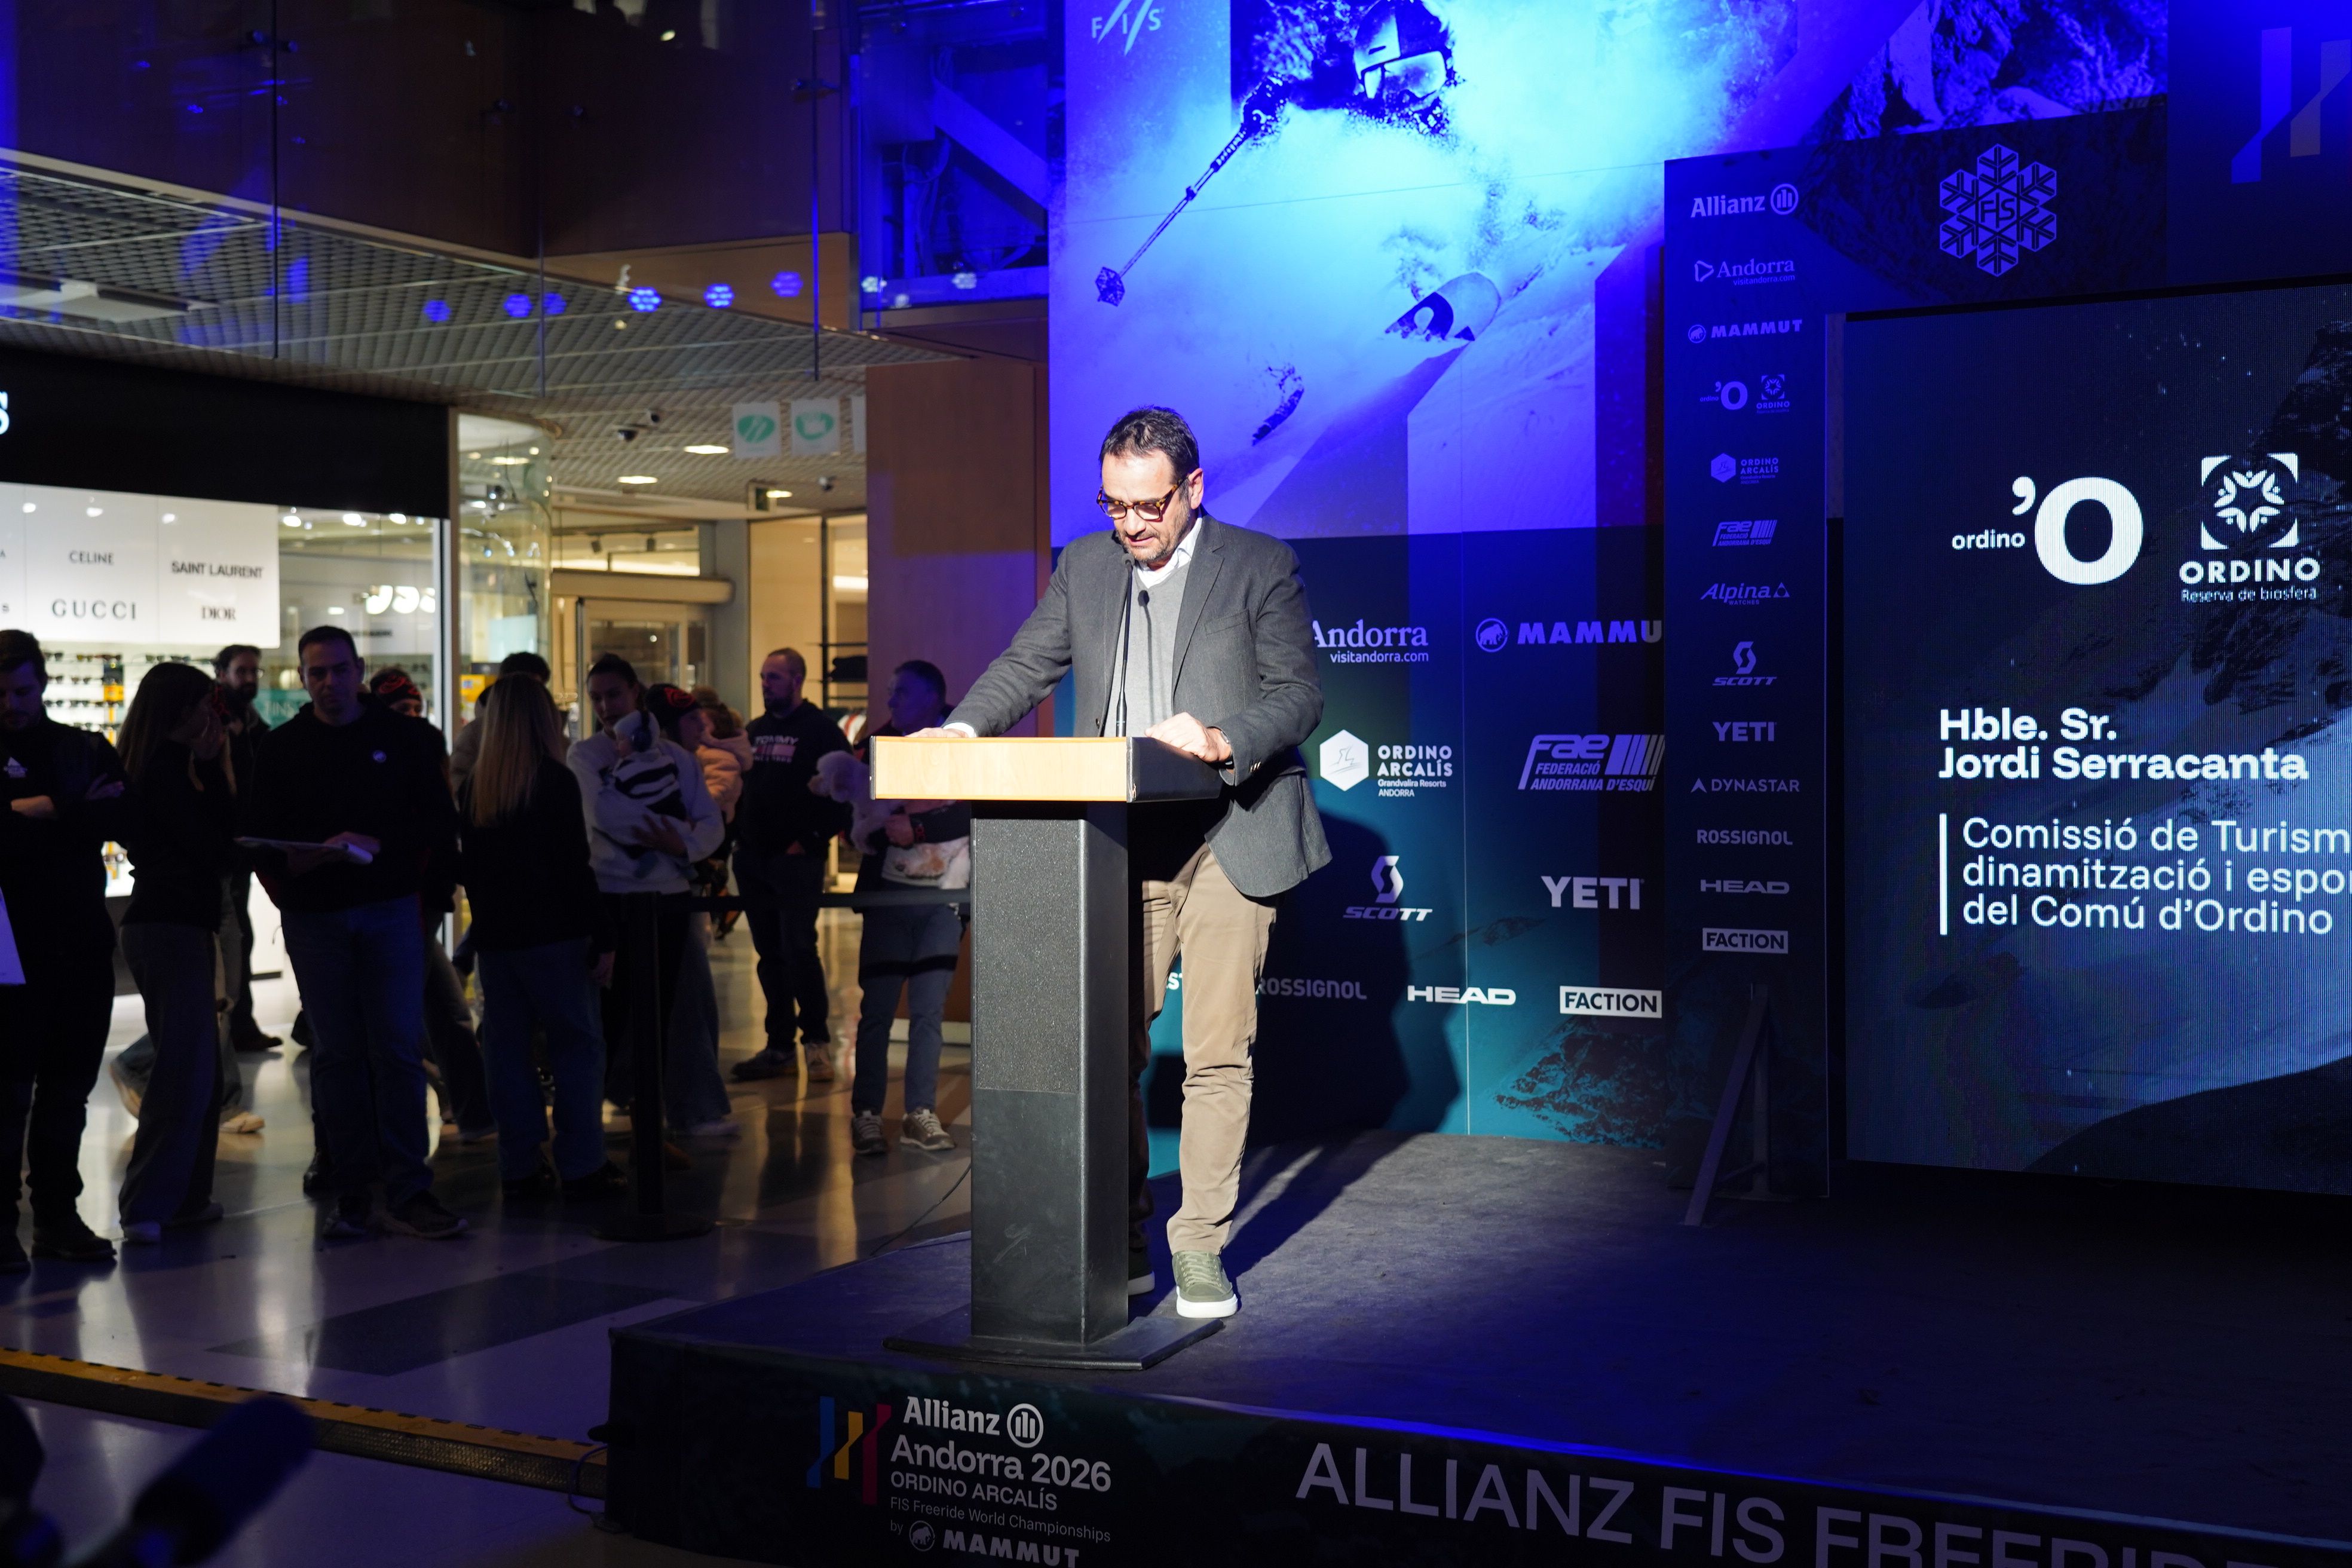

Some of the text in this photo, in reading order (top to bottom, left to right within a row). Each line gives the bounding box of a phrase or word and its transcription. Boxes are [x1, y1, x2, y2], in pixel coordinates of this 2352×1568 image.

[1690, 194, 1766, 218] Allianz
[1717, 258, 1795, 278] Andorra
[1733, 274, 1796, 286] visitandorra.com
[1711, 320, 1803, 338] MAMMUT
[1699, 395, 1719, 405] ordino
[1756, 400, 1790, 409] ORDINO
[1740, 457, 1779, 466] ORDINO
[1740, 464, 1779, 474] ARCALÍS
[1951, 529, 2026, 550] ordino
[69, 550, 114, 565] CELINE
[171, 561, 264, 578] SAINT LAURENT
[2179, 557, 2321, 584] ORDINO
[1700, 582, 1772, 604] Alpina
[2181, 586, 2317, 603] Reserva de biosfera
[51, 598, 137, 620] GUCCI
[201, 605, 237, 621] DIOR
[1312, 618, 1429, 648] Andorra
[1517, 620, 1662, 645] MAMMU
[1330, 650, 1429, 663] visitandorra.com
[1712, 676, 1777, 686] SCOTT
[1712, 721, 1775, 742] YETI
[1940, 707, 2117, 741] Hble. Sr.
[1377, 745, 1453, 760] ORDINO
[1377, 759, 1453, 777] ARCALÍS
[1535, 760, 1601, 776] FEDERACIÓ
[1938, 746, 2310, 780] Jordi Serracanta
[1377, 778, 1447, 788] Grandvalira Resorts
[1530, 778, 1603, 791] ANDORRANA
[1711, 778, 1800, 792] DYNASTAR
[1378, 789, 1415, 797] ANDORRA
[1696, 829, 1793, 846] ROSSIGNOL
[1962, 817, 2351, 855] Comissió de Turism
[1962, 855, 2211, 891] dinamització
[2225, 860, 2233, 892] i
[1541, 875, 1641, 910] YETI
[1700, 879, 1790, 895] HEAD
[1343, 906, 1433, 922] SCOTT
[1962, 893, 2333, 935] del Comú d’Ordino
[1706, 932, 1785, 950] FACTION
[1255, 977, 1367, 1000] ROSSIGNOL
[1407, 985, 1517, 1006] HEAD
[1564, 992, 1658, 1013] FACTION
[903, 1396, 1000, 1436] Allianz
[890, 1434, 1111, 1493] Andorra 2026
[890, 1471, 1058, 1511] ORDINO ARCALÍS
[1294, 1442, 2280, 1568] ALLIANZ FIS FREE
[890, 1497, 1111, 1543] FIS Freeride World Championships
[890, 1520, 904, 1536] by
[942, 1529, 1080, 1568] MAMMUT
